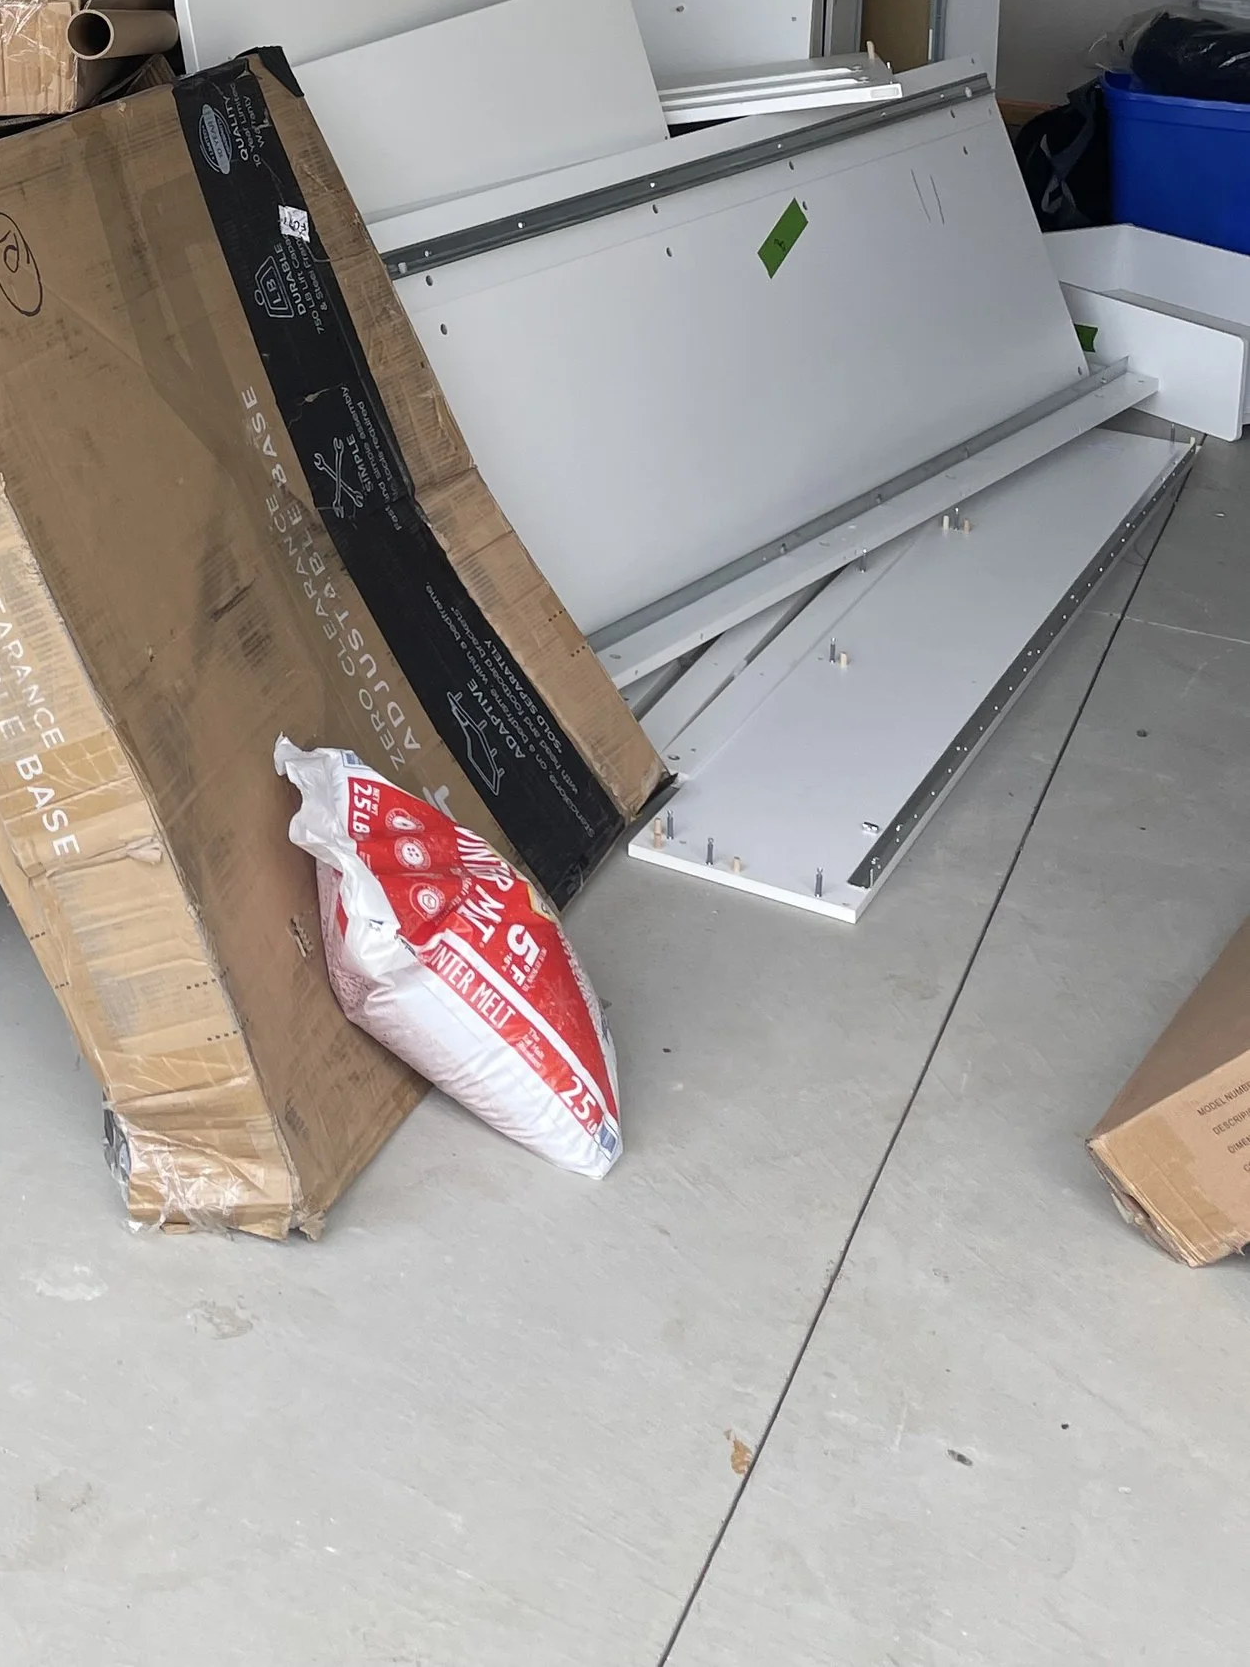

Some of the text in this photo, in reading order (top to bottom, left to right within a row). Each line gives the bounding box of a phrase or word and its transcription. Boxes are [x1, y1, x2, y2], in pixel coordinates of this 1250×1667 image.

[223, 95, 248, 161] QUALITY
[243, 95, 265, 148] Warranty
[245, 127, 256, 153] Year
[252, 153, 262, 168] 10
[265, 276, 281, 305] LB
[274, 242, 307, 316] DURABLE
[310, 273, 325, 300] Steel
[296, 270, 325, 335] 750 LB Lift
[357, 400, 380, 453] required
[346, 433, 374, 493] SIMPLE
[363, 442, 382, 480] simple
[378, 454, 393, 482] tools
[384, 505, 403, 531] Fast
[242, 385, 421, 750] ADJUSTABLE BASE
[265, 494, 406, 771] ZERO CLEARANCE
[466, 650, 489, 685] within
[484, 638, 537, 715] SEPARATELY
[484, 656, 524, 716] footboard
[467, 678, 526, 760] ADAPTIVE
[522, 715, 541, 739] and
[535, 752, 548, 771] on
[538, 739, 562, 770] head
[561, 768, 579, 795] with
[15, 754, 81, 856] BASE
[427, 943, 476, 995] INTER
[470, 983, 517, 1029] MELT
[559, 1075, 596, 1121] 25
[1197, 1097, 1226, 1116] MODEL
